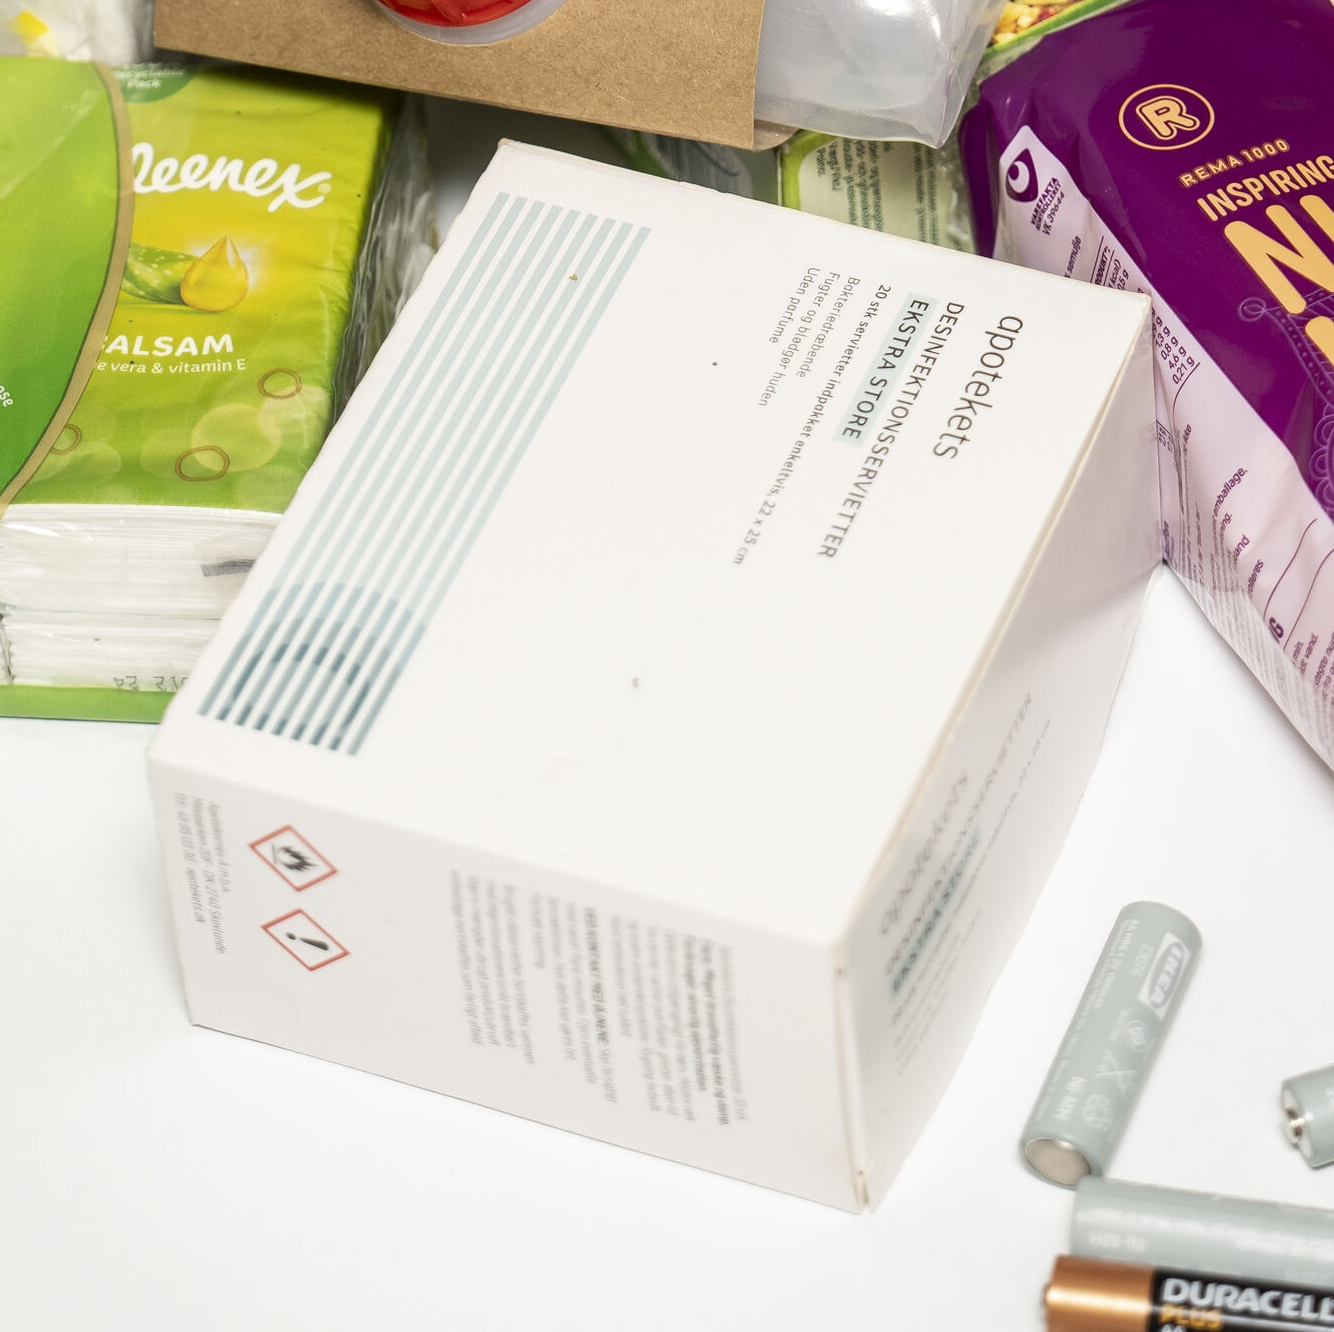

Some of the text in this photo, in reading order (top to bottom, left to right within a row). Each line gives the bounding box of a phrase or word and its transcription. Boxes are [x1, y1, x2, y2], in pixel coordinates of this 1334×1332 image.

[131, 142, 332, 212] leenex
[1179, 138, 1291, 189] REMA 1000
[1031, 177, 1058, 225] VAREFAKTA
[769, 267, 820, 345] Uden parfume
[867, 300, 881, 320] stk
[874, 283, 892, 299] 20
[101, 333, 233, 356] ALSAM
[758, 271, 840, 407] Fugter og blødgør huden
[796, 276, 861, 379] Bakteriedræbende
[834, 320, 869, 378] servietter
[111, 358, 246, 374] vera & vitamin E
[841, 299, 930, 440] EKSTRA STORE
[932, 315, 1024, 460] apotekets
[1173, 362, 1189, 384] 0,21
[801, 378, 836, 442] indpakket
[817, 301, 965, 559] DESINFEKTIONSSERVIETTER
[765, 439, 804, 497] enkeltvis,
[1213, 468, 1248, 517] emballage.
[759, 500, 776, 516] 22
[733, 545, 749, 566] cm
[744, 528, 762, 545] 25
[1150, 944, 1184, 1006] IKEA
